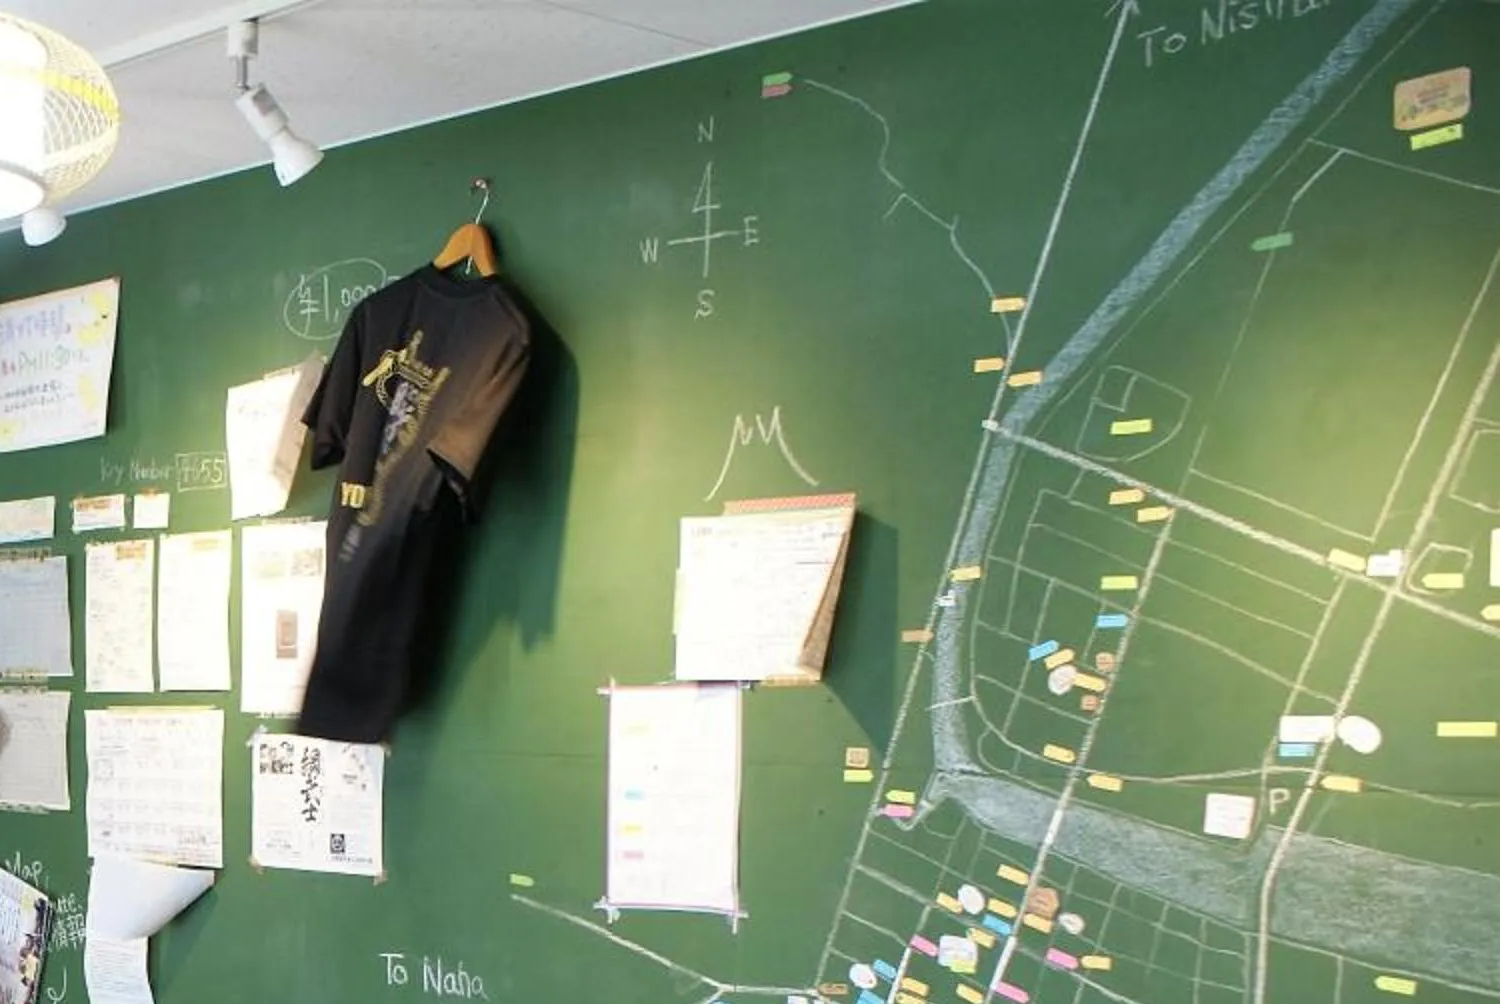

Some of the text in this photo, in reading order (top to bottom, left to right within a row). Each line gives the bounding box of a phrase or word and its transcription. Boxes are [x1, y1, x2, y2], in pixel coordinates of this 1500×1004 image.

[1137, 26, 1187, 68] To
[697, 116, 714, 143] N
[743, 215, 760, 247] E
[639, 238, 659, 264] W
[694, 289, 716, 320] S
[1269, 787, 1291, 815] P
[379, 952, 491, 1001] To Naha
